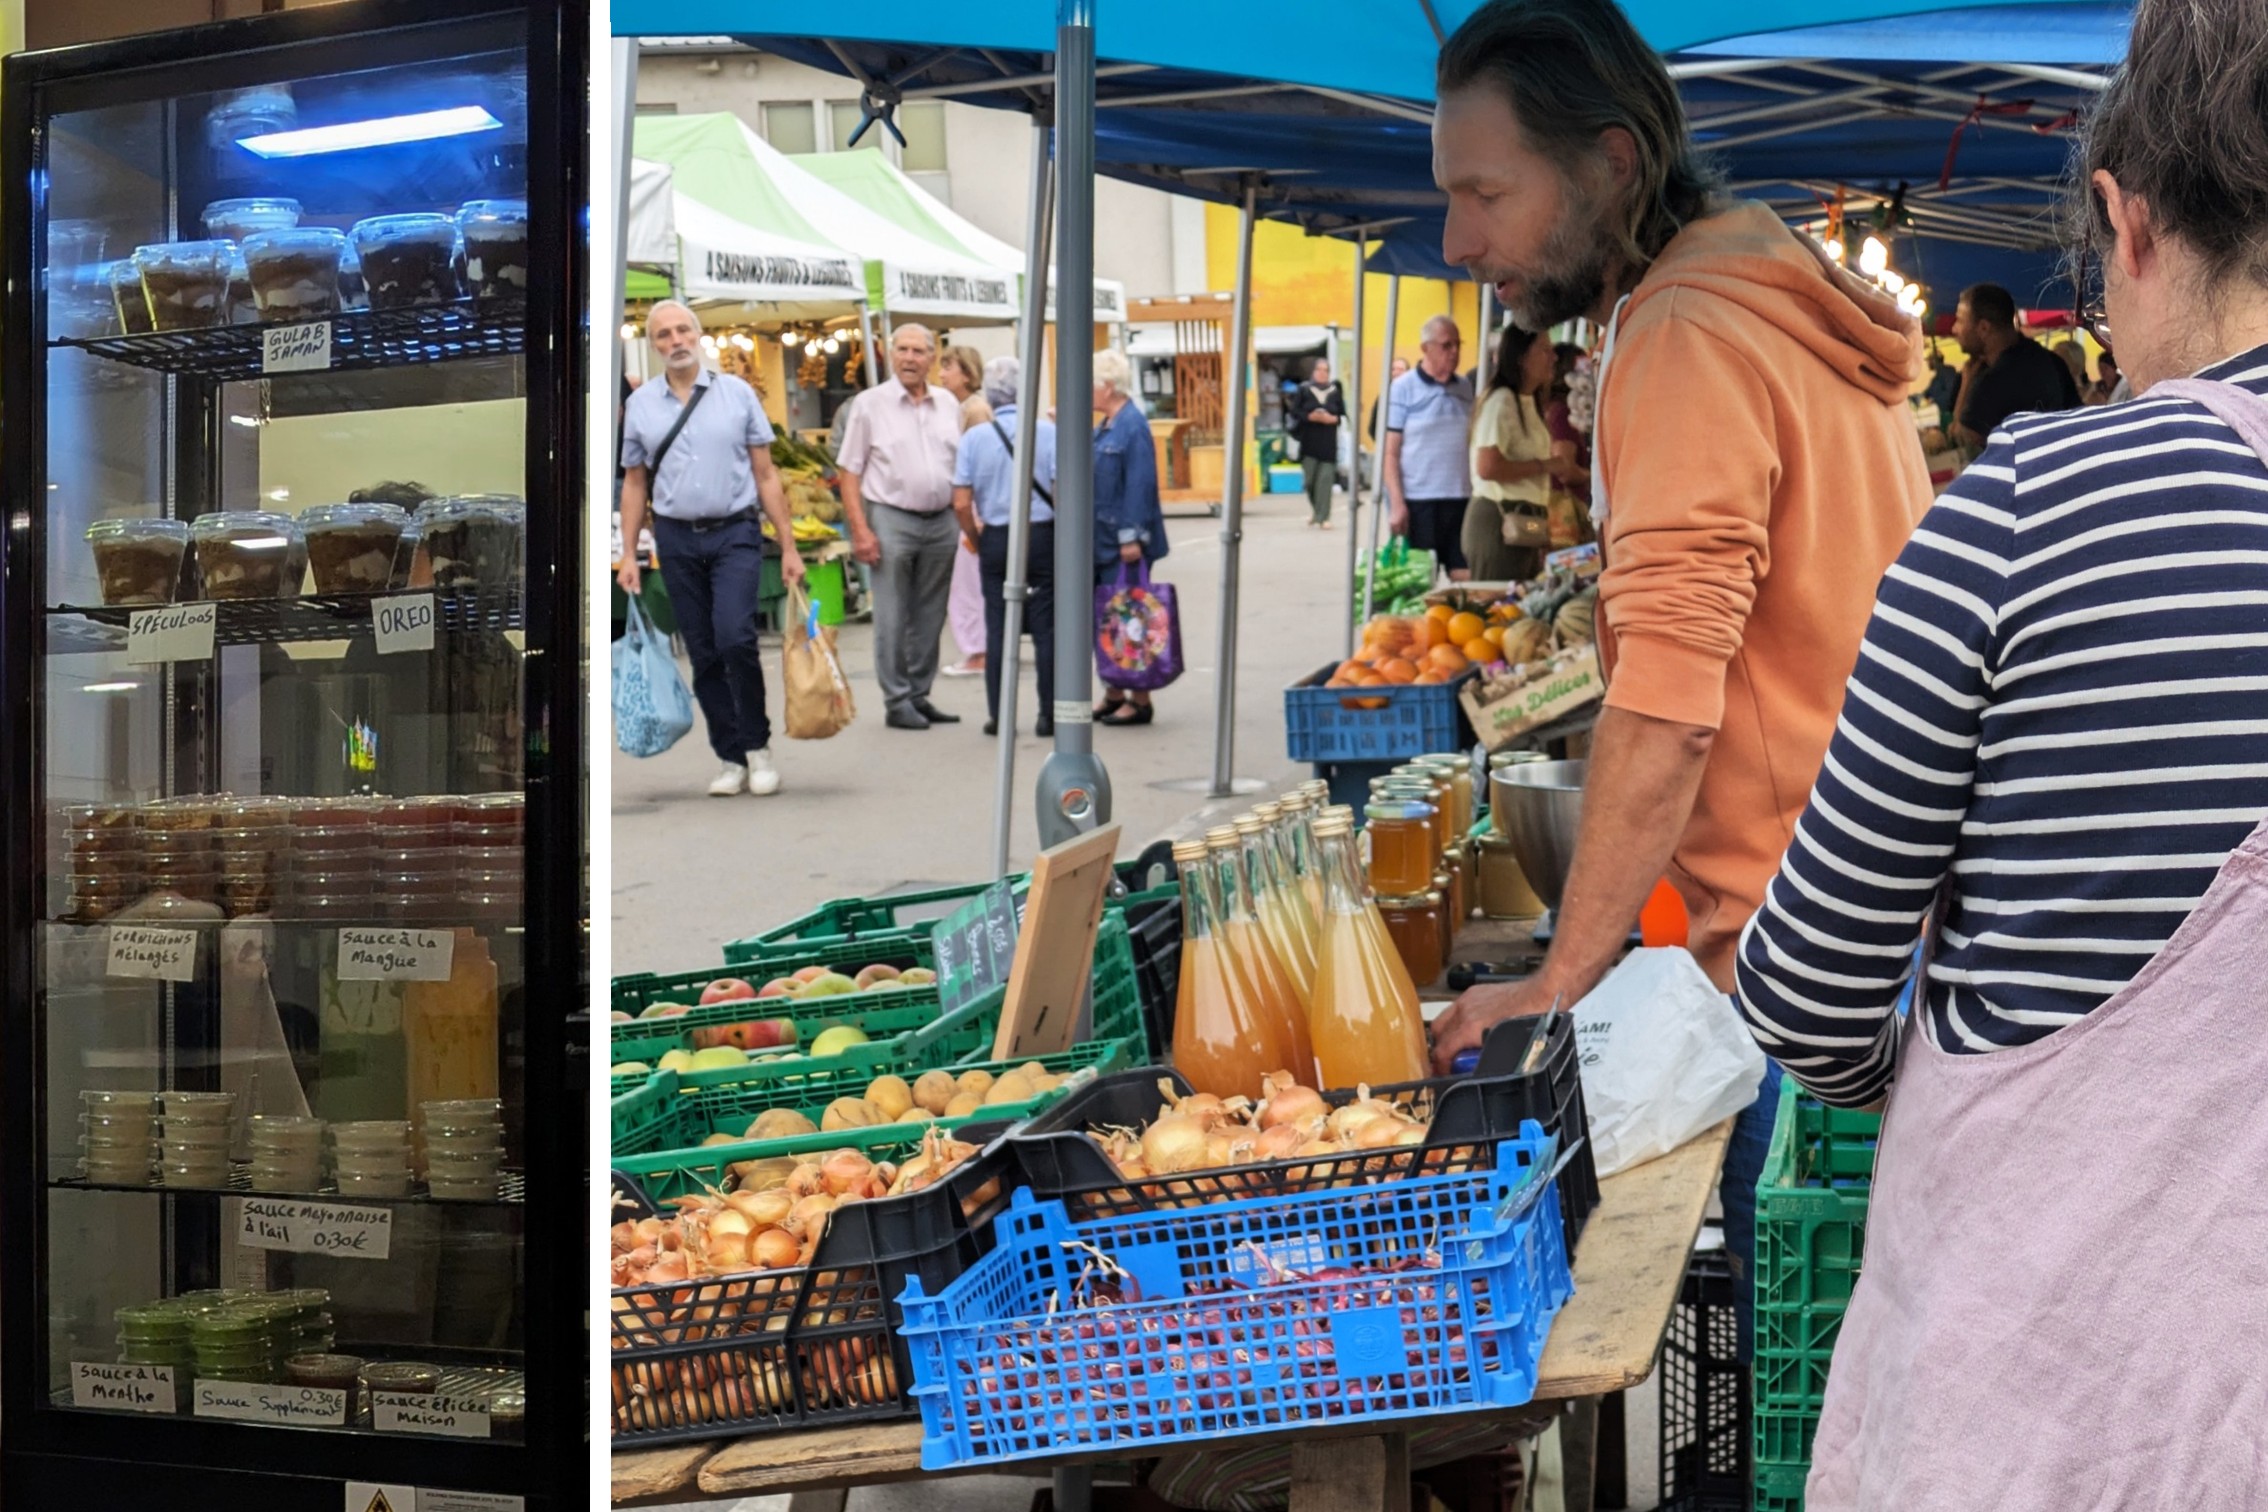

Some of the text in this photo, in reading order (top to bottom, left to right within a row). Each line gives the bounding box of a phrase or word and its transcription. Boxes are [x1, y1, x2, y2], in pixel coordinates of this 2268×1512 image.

[716, 251, 764, 284] SAISONS
[765, 256, 801, 284] FRUITS
[269, 323, 325, 346] GULAB
[270, 339, 325, 361] JAMAN
[380, 605, 431, 635] OREO
[418, 933, 437, 949] la
[351, 950, 418, 972] Mangue
[244, 1217, 254, 1233] à
[152, 1367, 169, 1383] la
[91, 1383, 155, 1404] Menthe
[202, 1390, 251, 1407] Sauce
